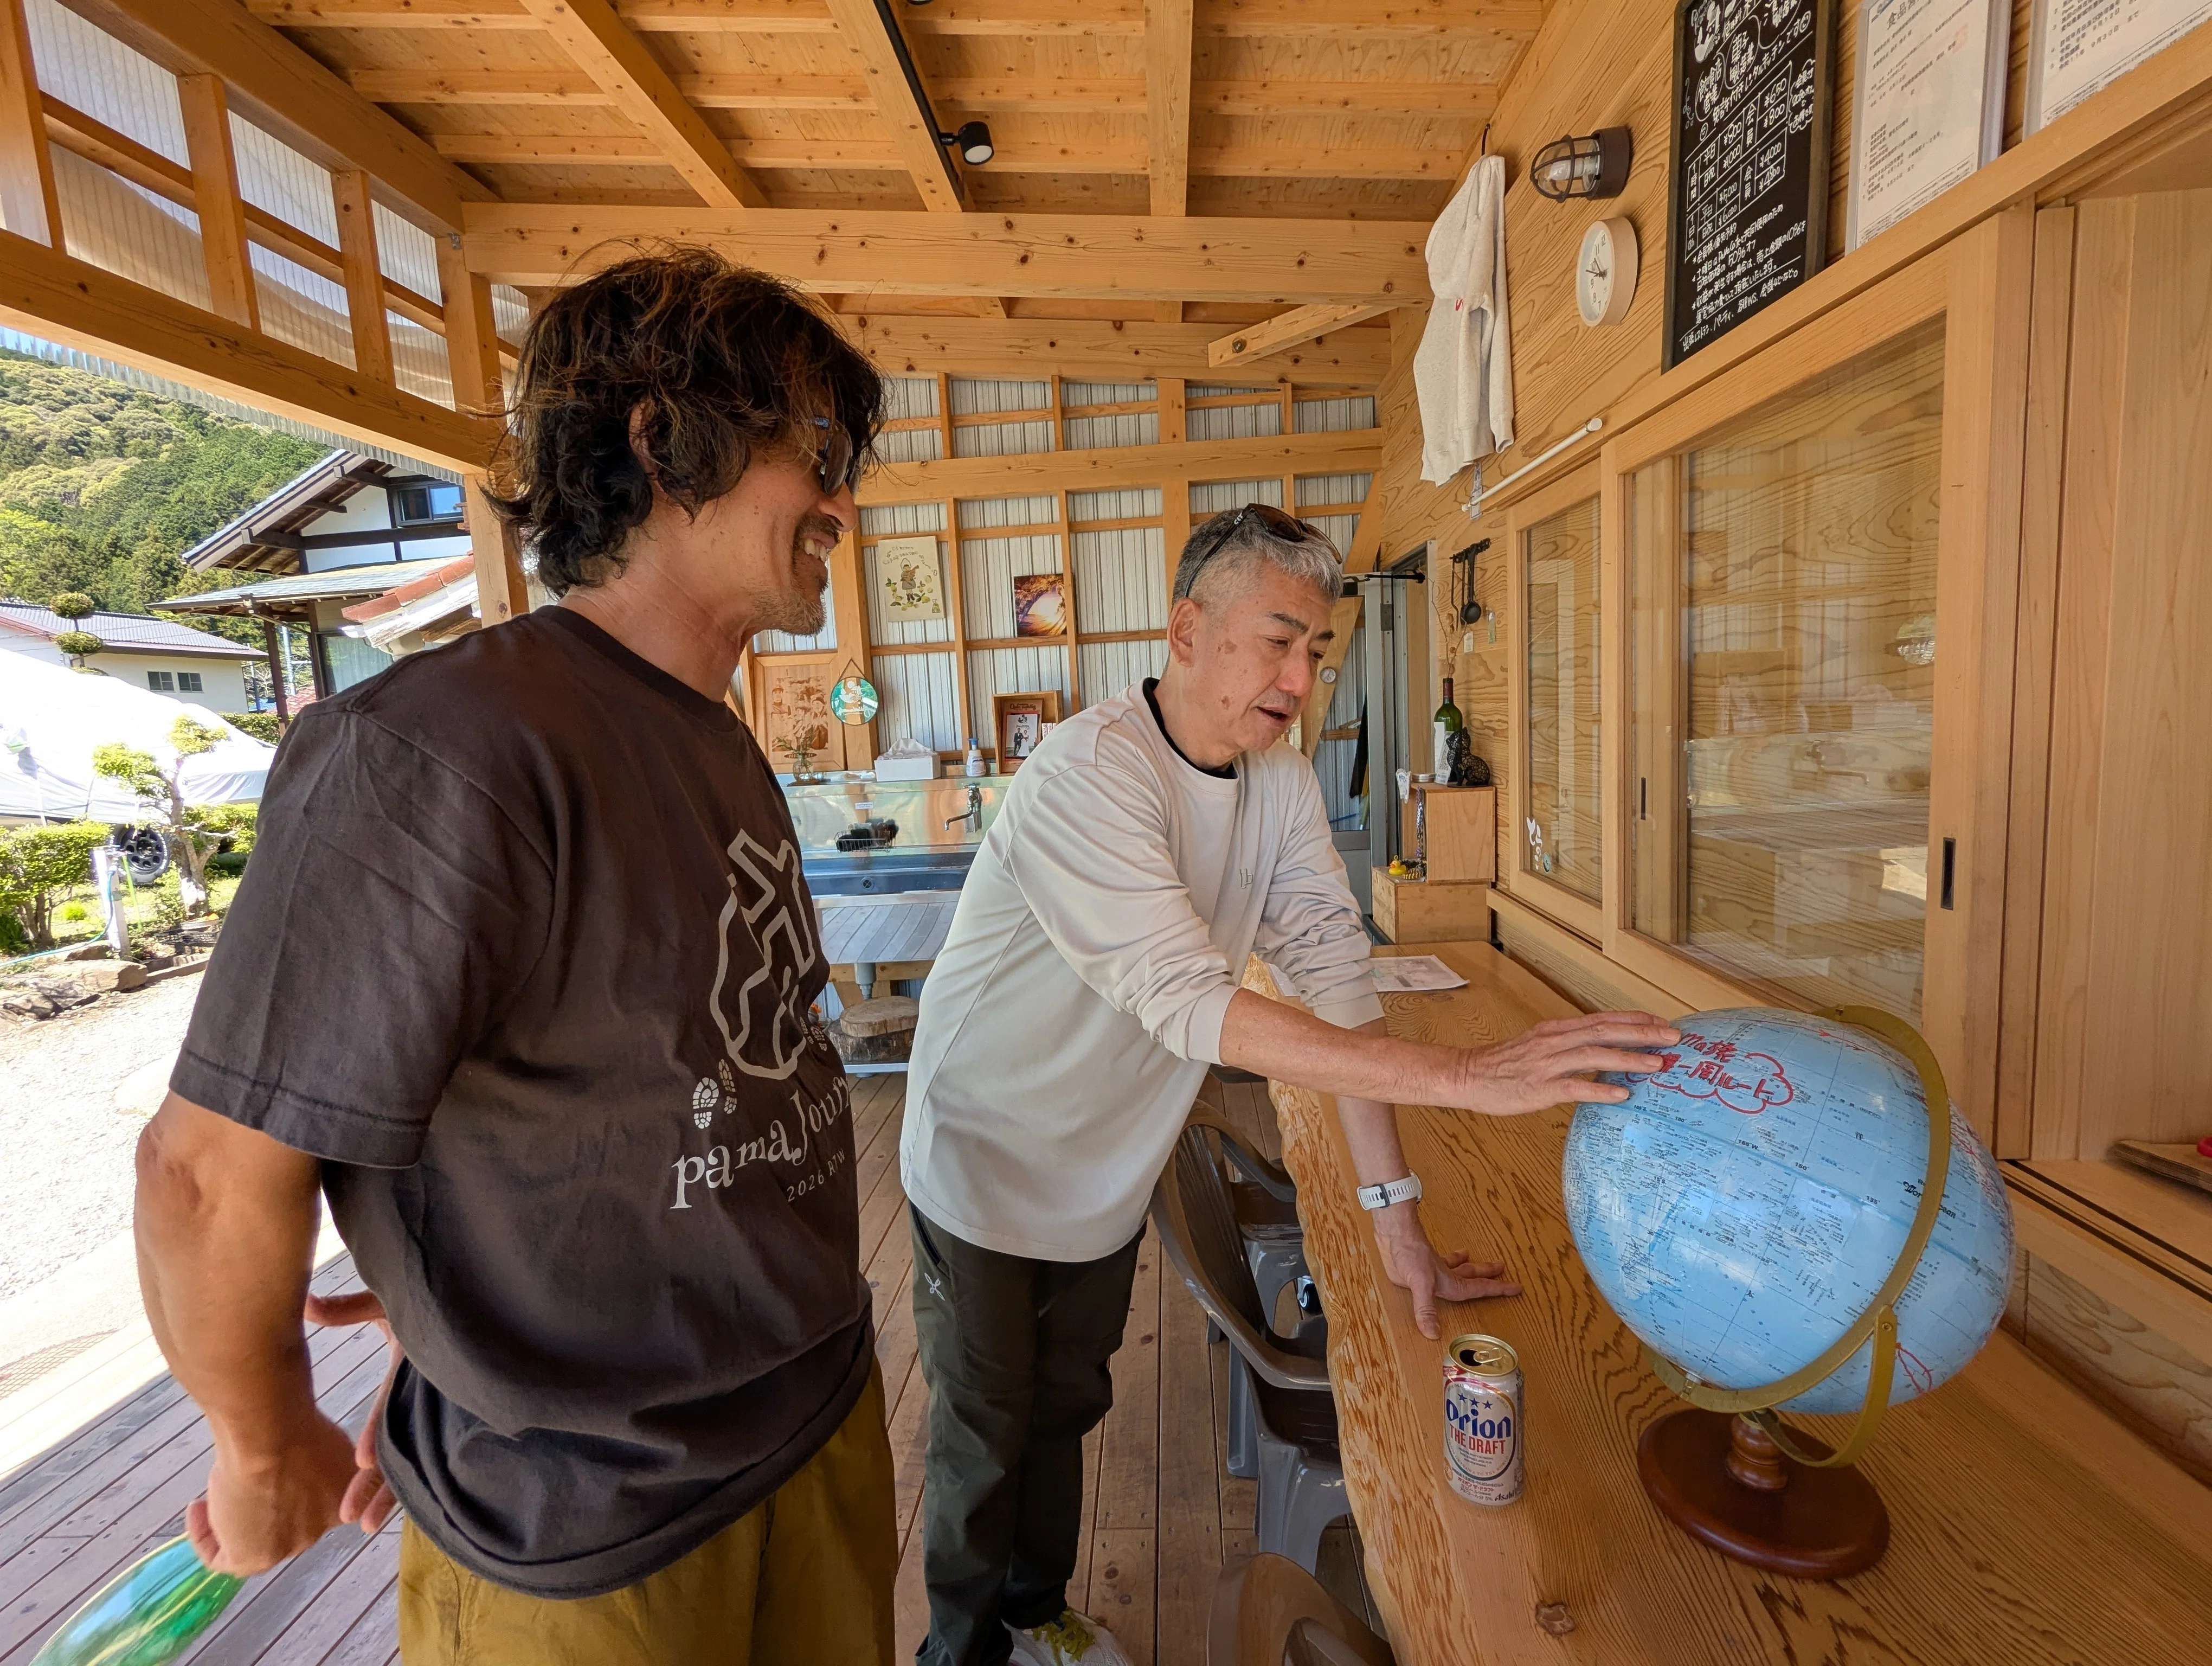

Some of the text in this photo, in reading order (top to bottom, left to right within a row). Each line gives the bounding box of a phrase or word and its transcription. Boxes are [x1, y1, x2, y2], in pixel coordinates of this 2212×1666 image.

[1764, 78, 1787, 108] ¥650
[1763, 103, 1785, 129] ¥800
[787, 1169, 824, 1202] 2026
[1446, 1398, 1511, 1439] Orion
[1450, 1423, 1466, 1448] THE
[1469, 1436, 1506, 1454] DRAFT
[1495, 1490, 1514, 1502] Asahi
